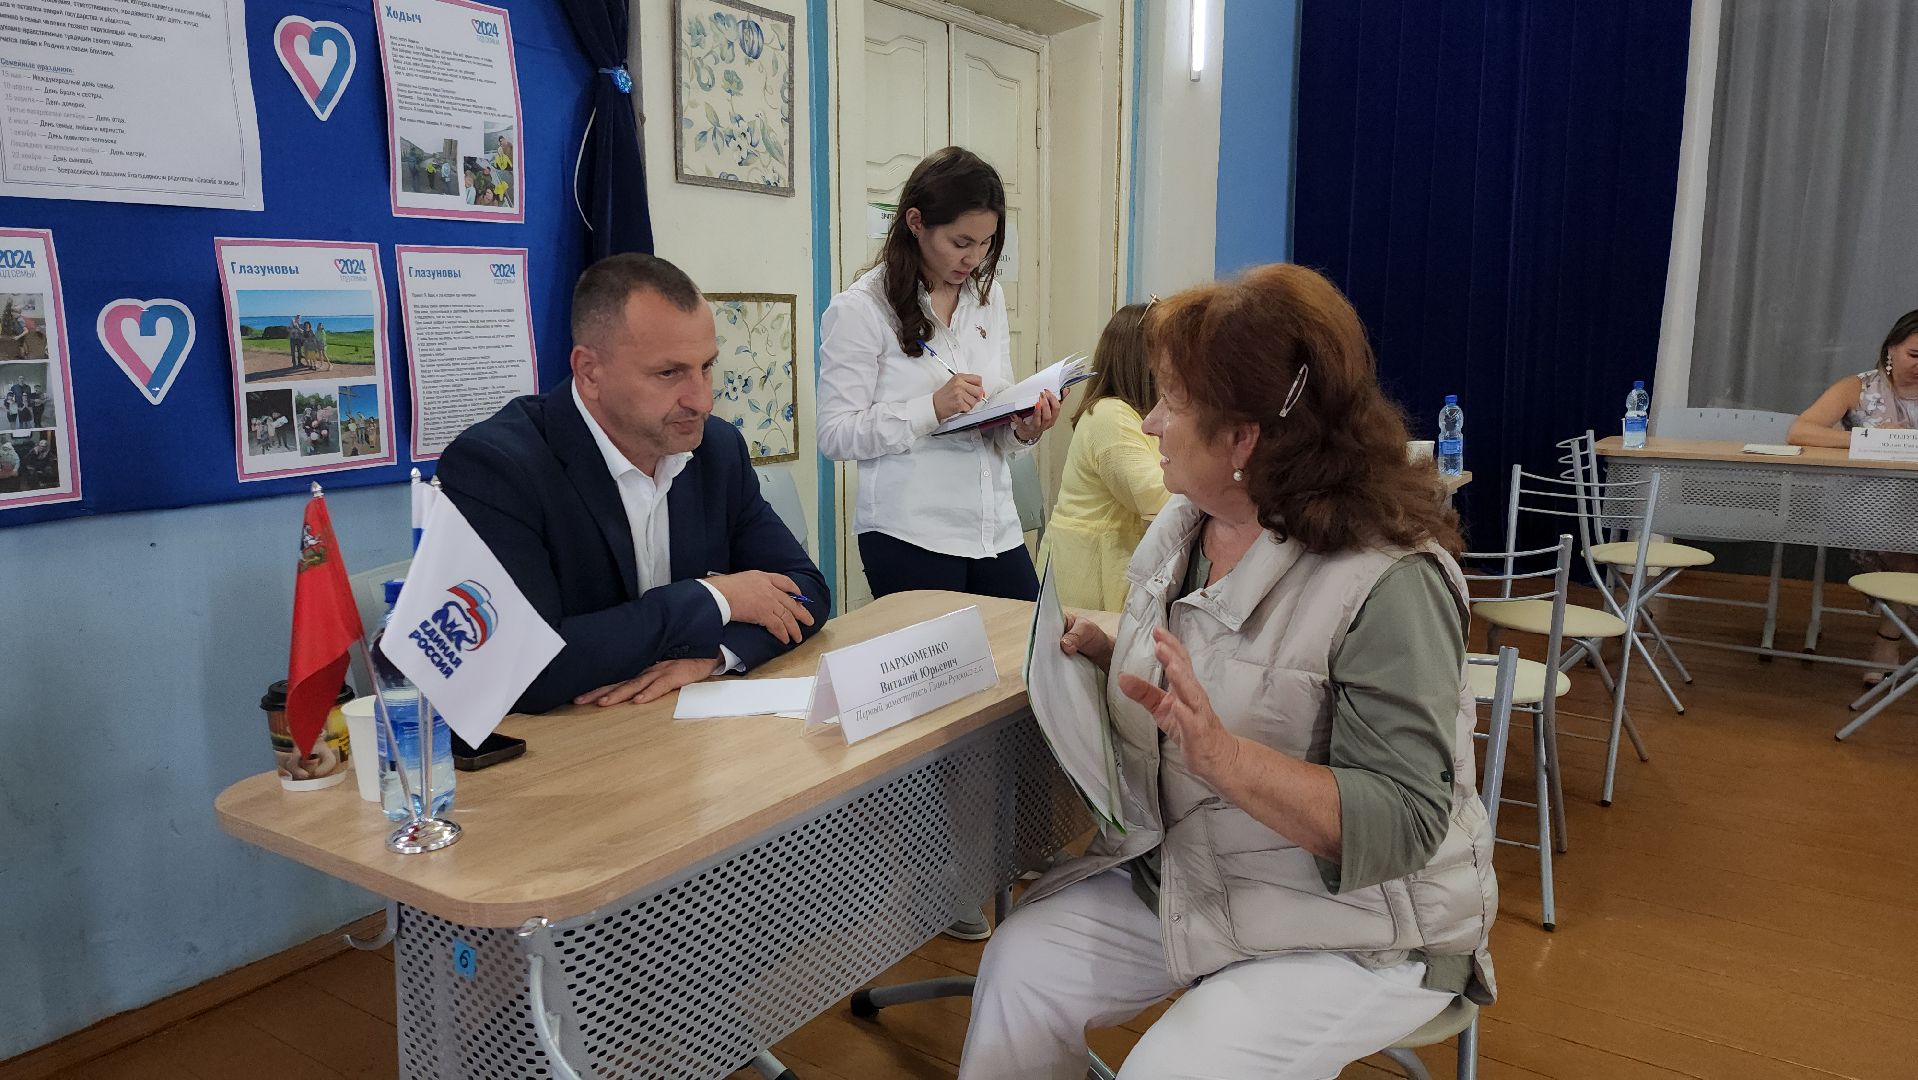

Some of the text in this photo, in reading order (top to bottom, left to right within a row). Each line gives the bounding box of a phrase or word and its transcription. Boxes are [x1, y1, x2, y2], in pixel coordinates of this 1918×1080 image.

[385, 5, 422, 23] Ходыч
[475, 19, 499, 38] 2024
[0, 249, 35, 268] 2024
[338, 258, 367, 275] 2024
[230, 261, 300, 277] Глазуновы
[408, 266, 462, 280] Глазуновы
[493, 263, 516, 278] 2024
[419, 620, 463, 668] ЕДИНАЯ
[408, 630, 454, 679] РОССИЯ
[880, 641, 949, 675] ПАРХОМЕНКО
[880, 658, 958, 694] Виталий Юрьевич
[459, 949, 471, 969] 6
